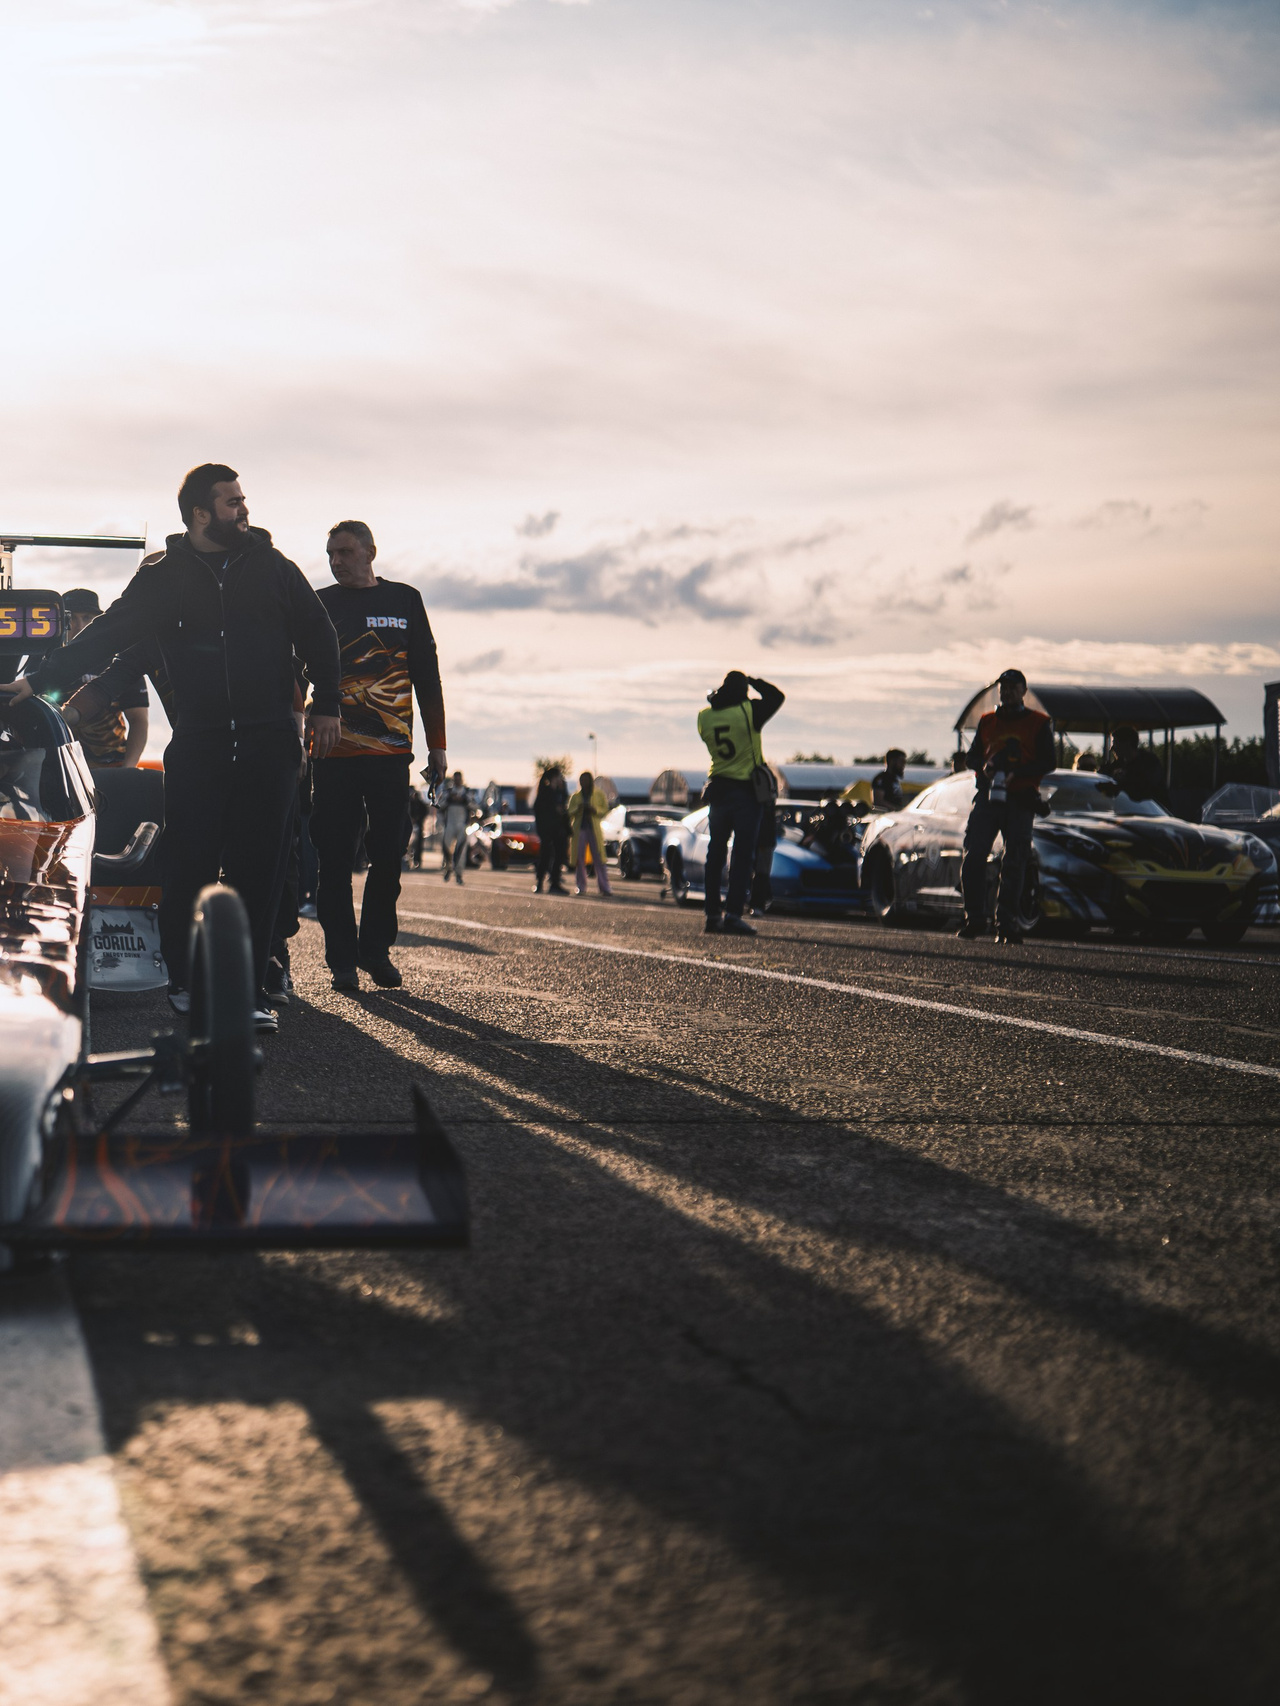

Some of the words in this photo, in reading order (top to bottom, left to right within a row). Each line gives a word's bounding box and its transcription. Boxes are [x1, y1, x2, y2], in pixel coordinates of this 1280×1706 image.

[365, 616, 408, 629] RDRC
[714, 725, 736, 761] 5
[93, 935, 147, 951] GORILLA
